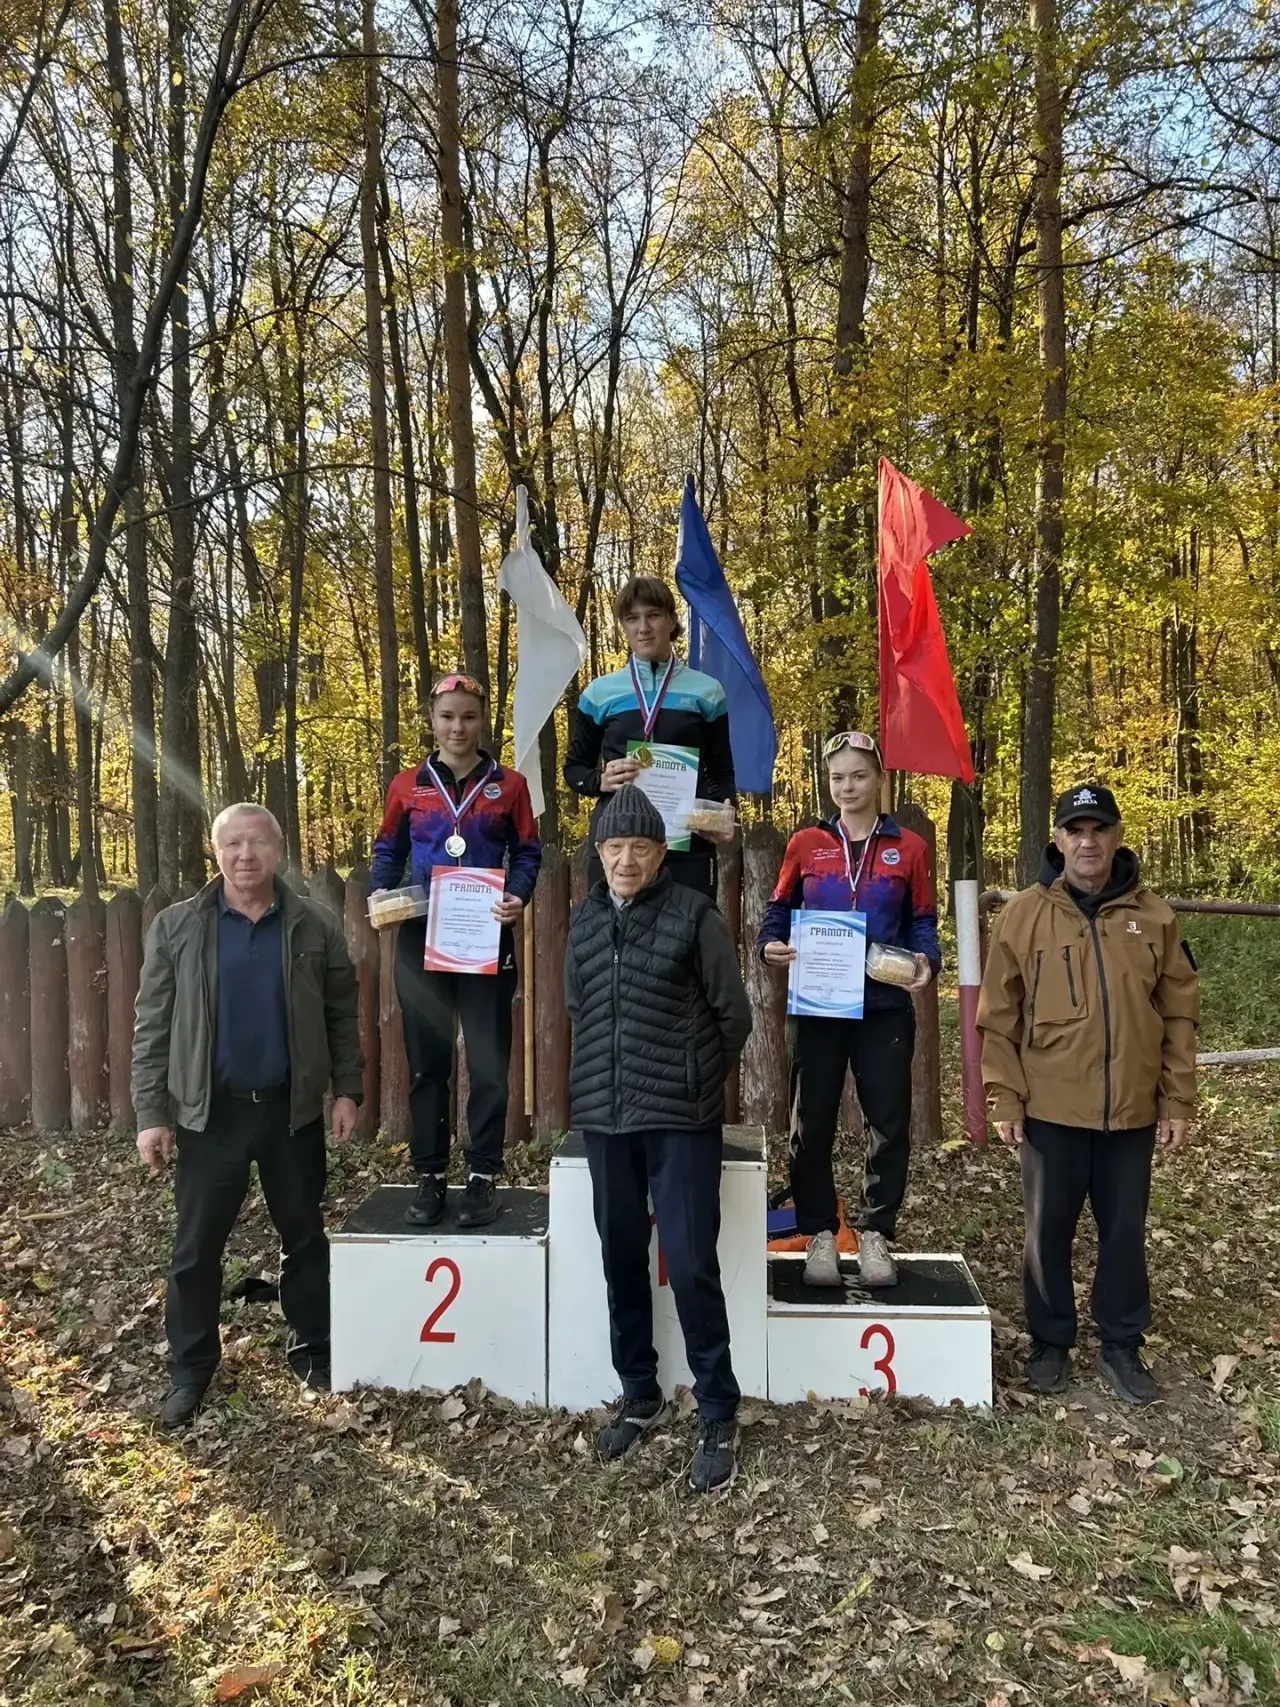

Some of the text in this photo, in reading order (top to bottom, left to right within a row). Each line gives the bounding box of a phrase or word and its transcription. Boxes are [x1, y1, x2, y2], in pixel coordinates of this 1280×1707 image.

[650, 760, 687, 771] РАМОТА
[449, 882, 492, 893] ГРАМОТА
[810, 927, 854, 938] ГРАМОТА
[419, 1256, 463, 1343] 2
[858, 1322, 897, 1399] 3
